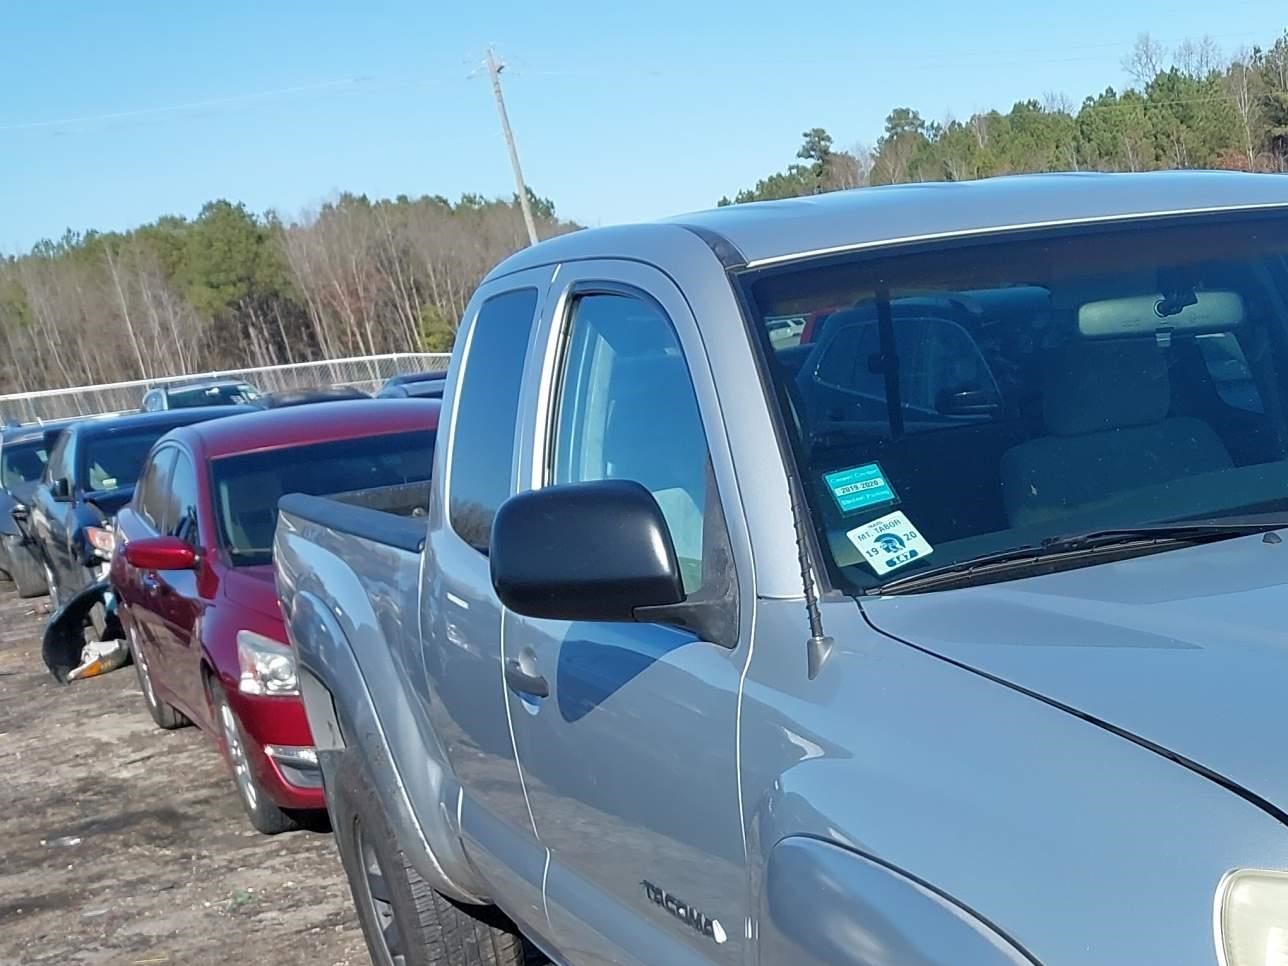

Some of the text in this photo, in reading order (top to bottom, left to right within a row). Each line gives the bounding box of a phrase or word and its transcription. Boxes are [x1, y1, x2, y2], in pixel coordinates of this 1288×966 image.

[874, 519, 902, 536] TABOR
[904, 530, 918, 543] 20
[865, 546, 880, 560] 19
[640, 879, 728, 945] TACOMA
